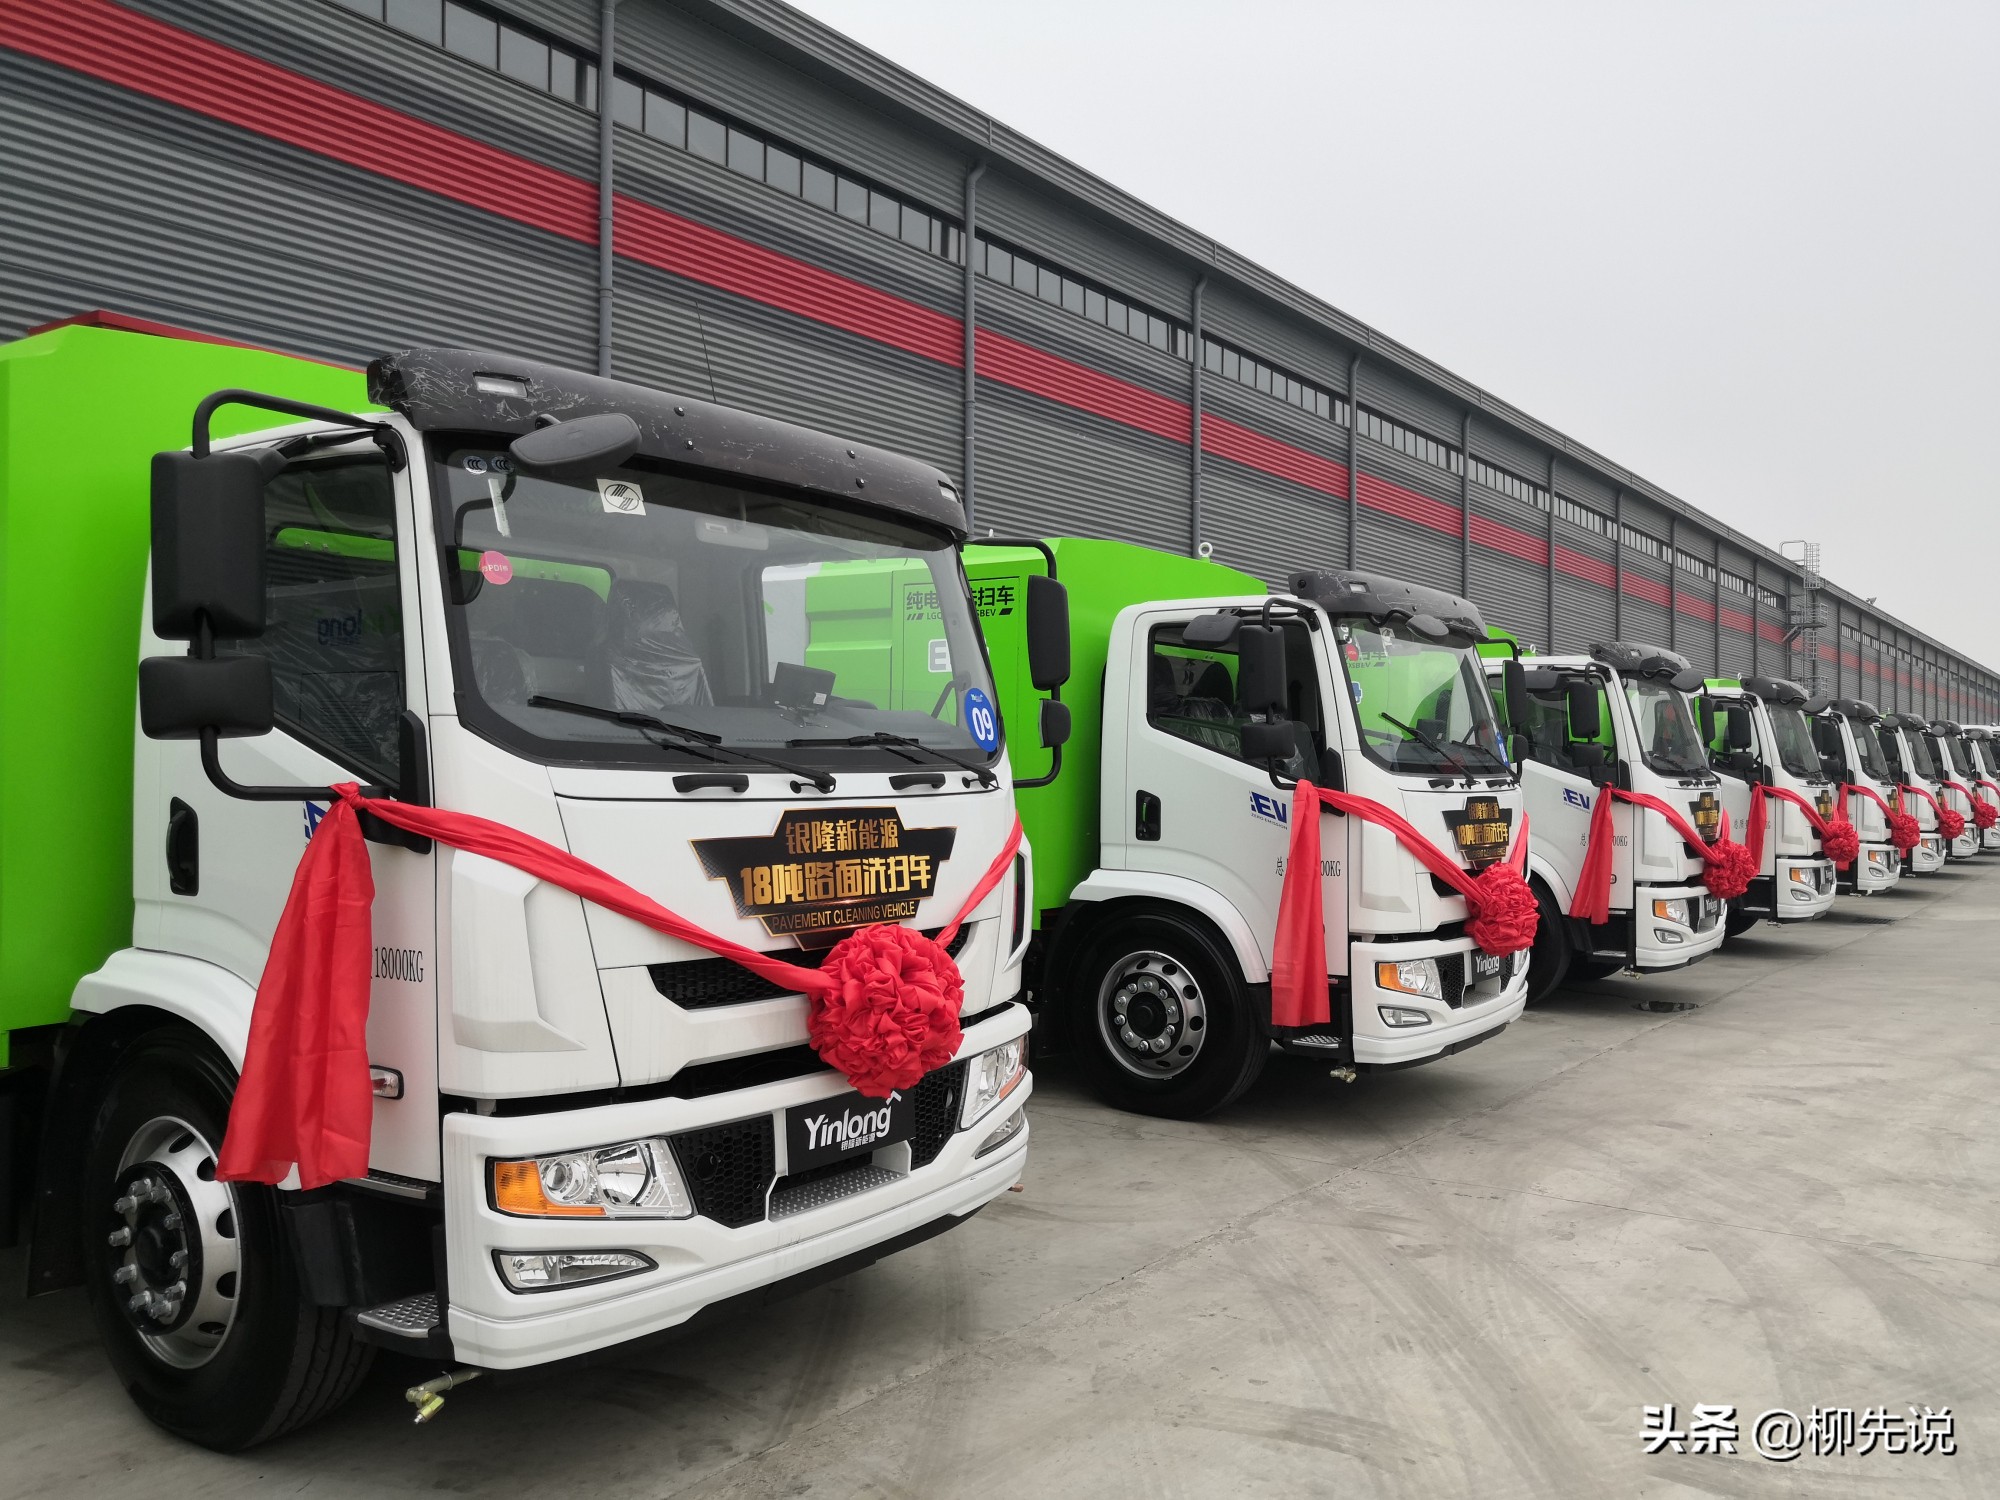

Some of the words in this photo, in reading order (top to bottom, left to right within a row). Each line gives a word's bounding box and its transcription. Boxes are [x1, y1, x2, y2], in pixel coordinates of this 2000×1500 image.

[972, 707, 994, 741] 09
[785, 818, 898, 855] 银隆新能源
[740, 854, 931, 906] 18吨路面洗扫车
[772, 910, 832, 931] PAVEMENT
[833, 905, 881, 926] CLEANING
[881, 901, 916, 918] VEHICLE
[374, 946, 424, 983] 18000KG
[804, 1106, 891, 1151] Yinlong
